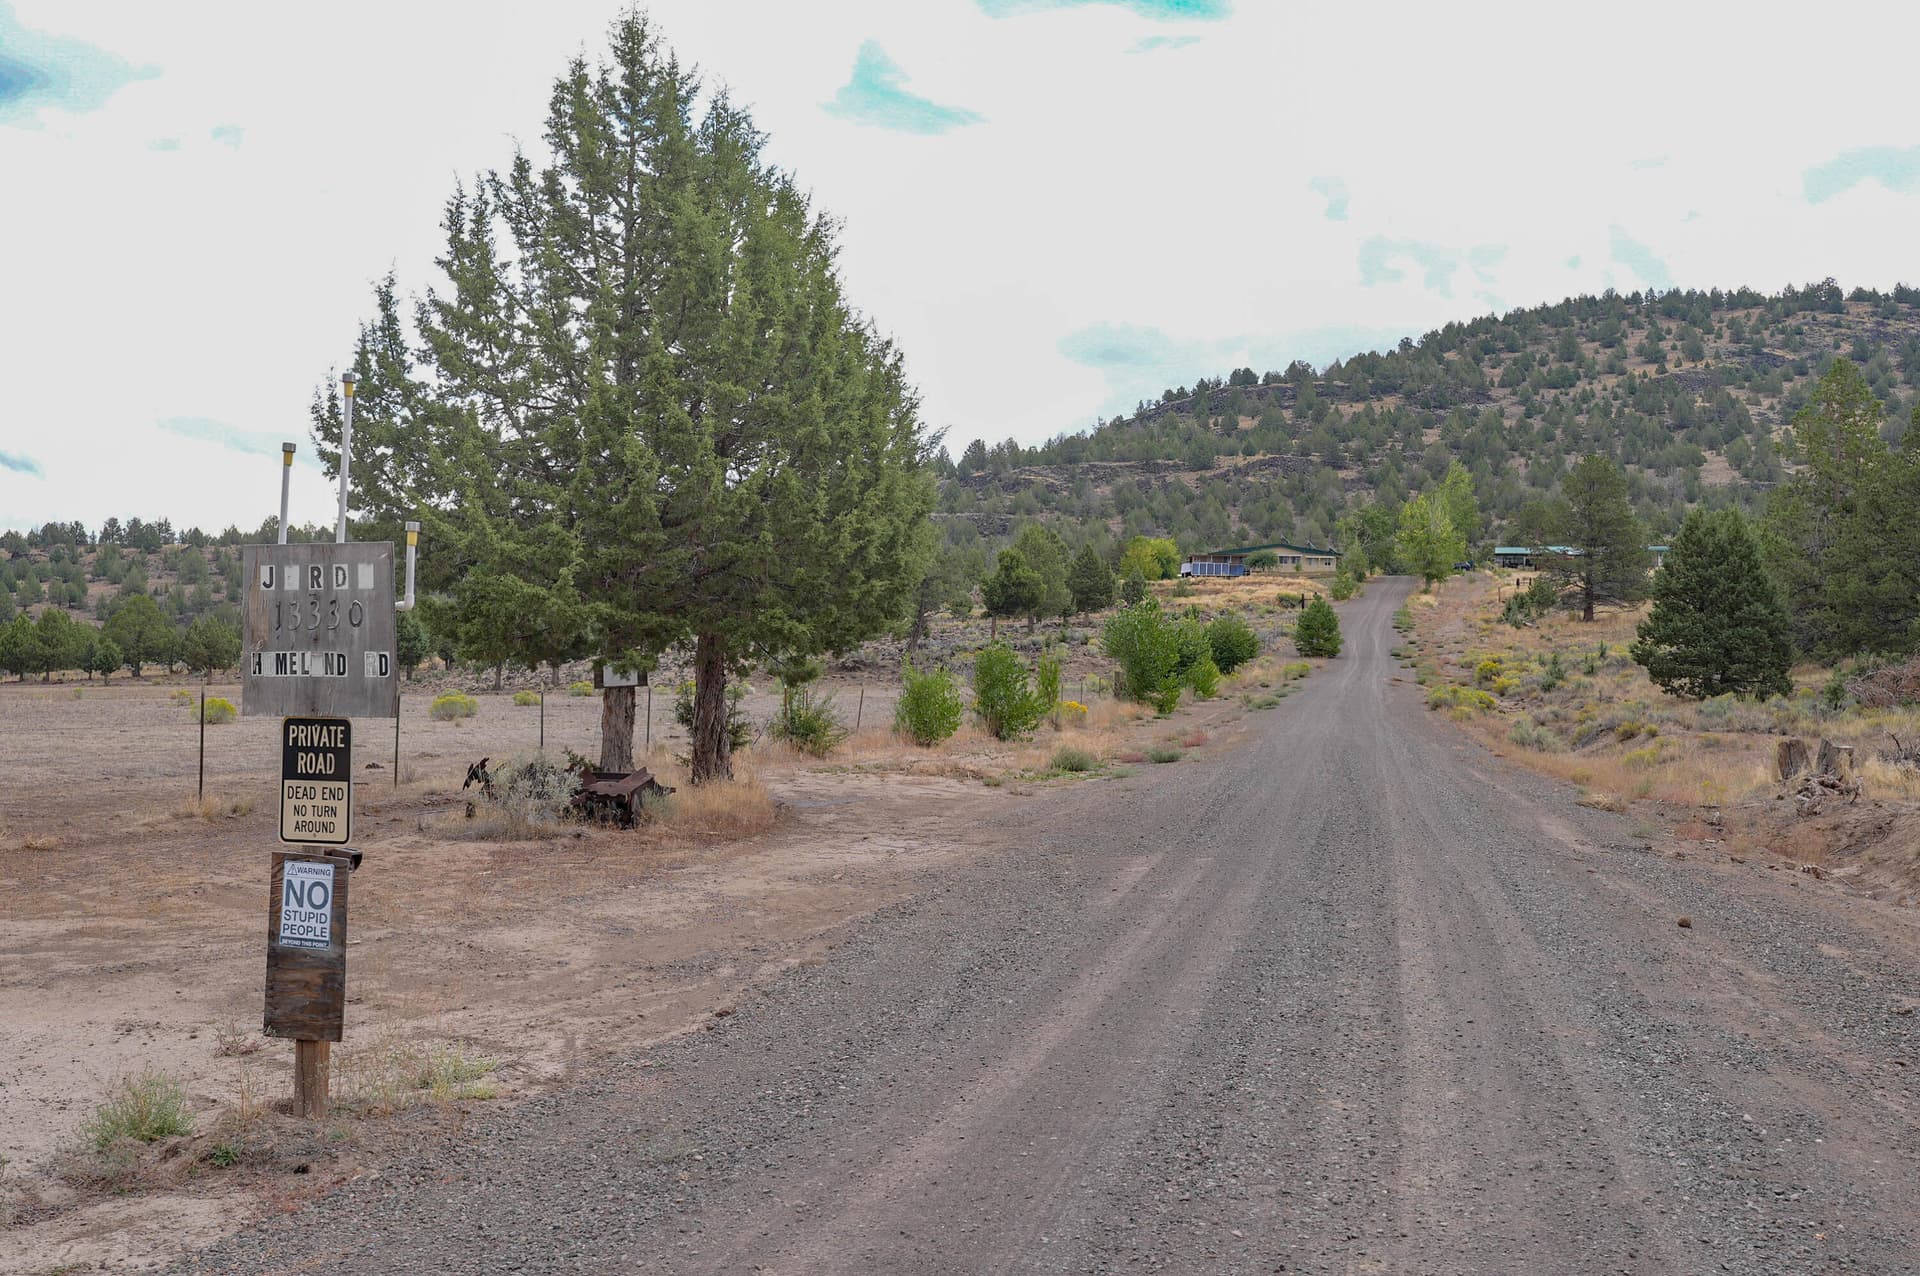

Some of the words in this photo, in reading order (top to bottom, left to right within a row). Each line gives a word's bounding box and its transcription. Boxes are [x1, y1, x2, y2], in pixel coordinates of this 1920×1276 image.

[275, 600, 363, 631] 13330
[252, 652, 347, 676] HMELND
[288, 725, 345, 748] PRIVATE
[297, 752, 336, 775] ROAD
[287, 785, 317, 801] DEAD
[321, 787, 344, 801] END
[293, 804, 307, 817] NO
[311, 805, 337, 818] TURN
[294, 820, 336, 834] AROUND
[297, 866, 331, 877] WARNING
[284, 878, 330, 910] NO
[283, 909, 328, 925] STUPID
[282, 923, 328, 938] PEOPLE
